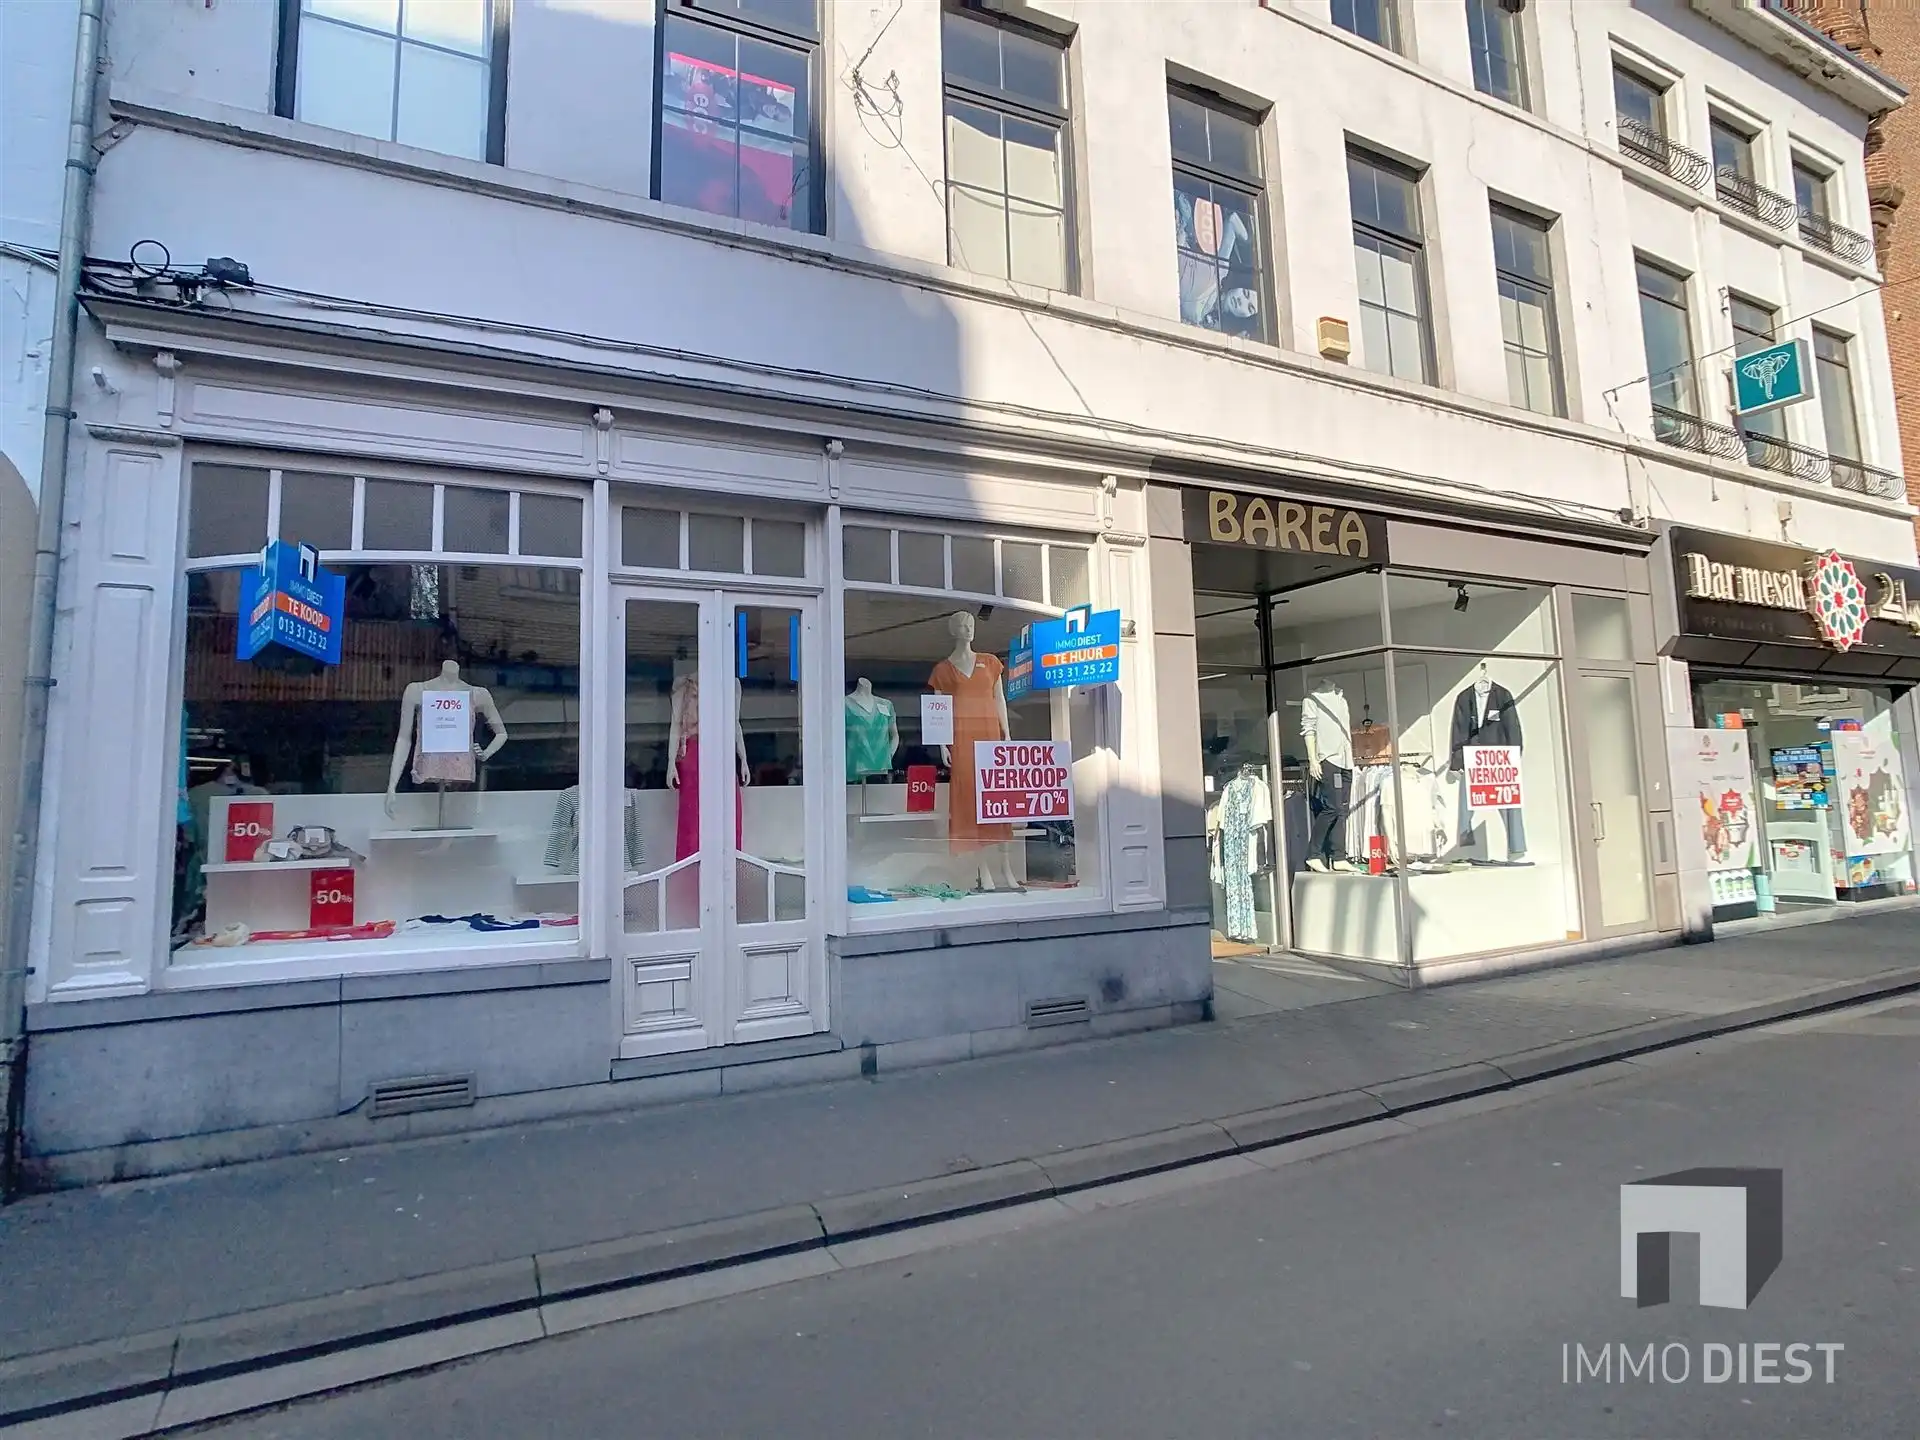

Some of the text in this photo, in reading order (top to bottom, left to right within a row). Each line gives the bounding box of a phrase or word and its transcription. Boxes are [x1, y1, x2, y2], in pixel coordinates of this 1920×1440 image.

[1208, 490, 1369, 558] BAREA
[1683, 552, 1736, 600] Dar
[288, 597, 299, 616] TE
[301, 604, 324, 627] KOOP
[279, 616, 294, 635] 013
[296, 624, 306, 640] 31
[308, 630, 317, 645] 25
[318, 635, 327, 650] 22
[1054, 647, 1104, 665] TE HUUR
[1045, 668, 1064, 680] 013
[1067, 666, 1079, 677] 31
[1083, 664, 1096, 675] 25
[1100, 661, 1113, 673] 22
[430, 699, 462, 710] -70%
[993, 745, 1055, 766] STOCK
[1475, 750, 1511, 766] STOCK
[980, 767, 1068, 789] VERKOOP
[1468, 767, 1519, 783] VERKOOP
[985, 790, 1066, 816] tot -70%
[1472, 784, 1519, 804] tot -70%
